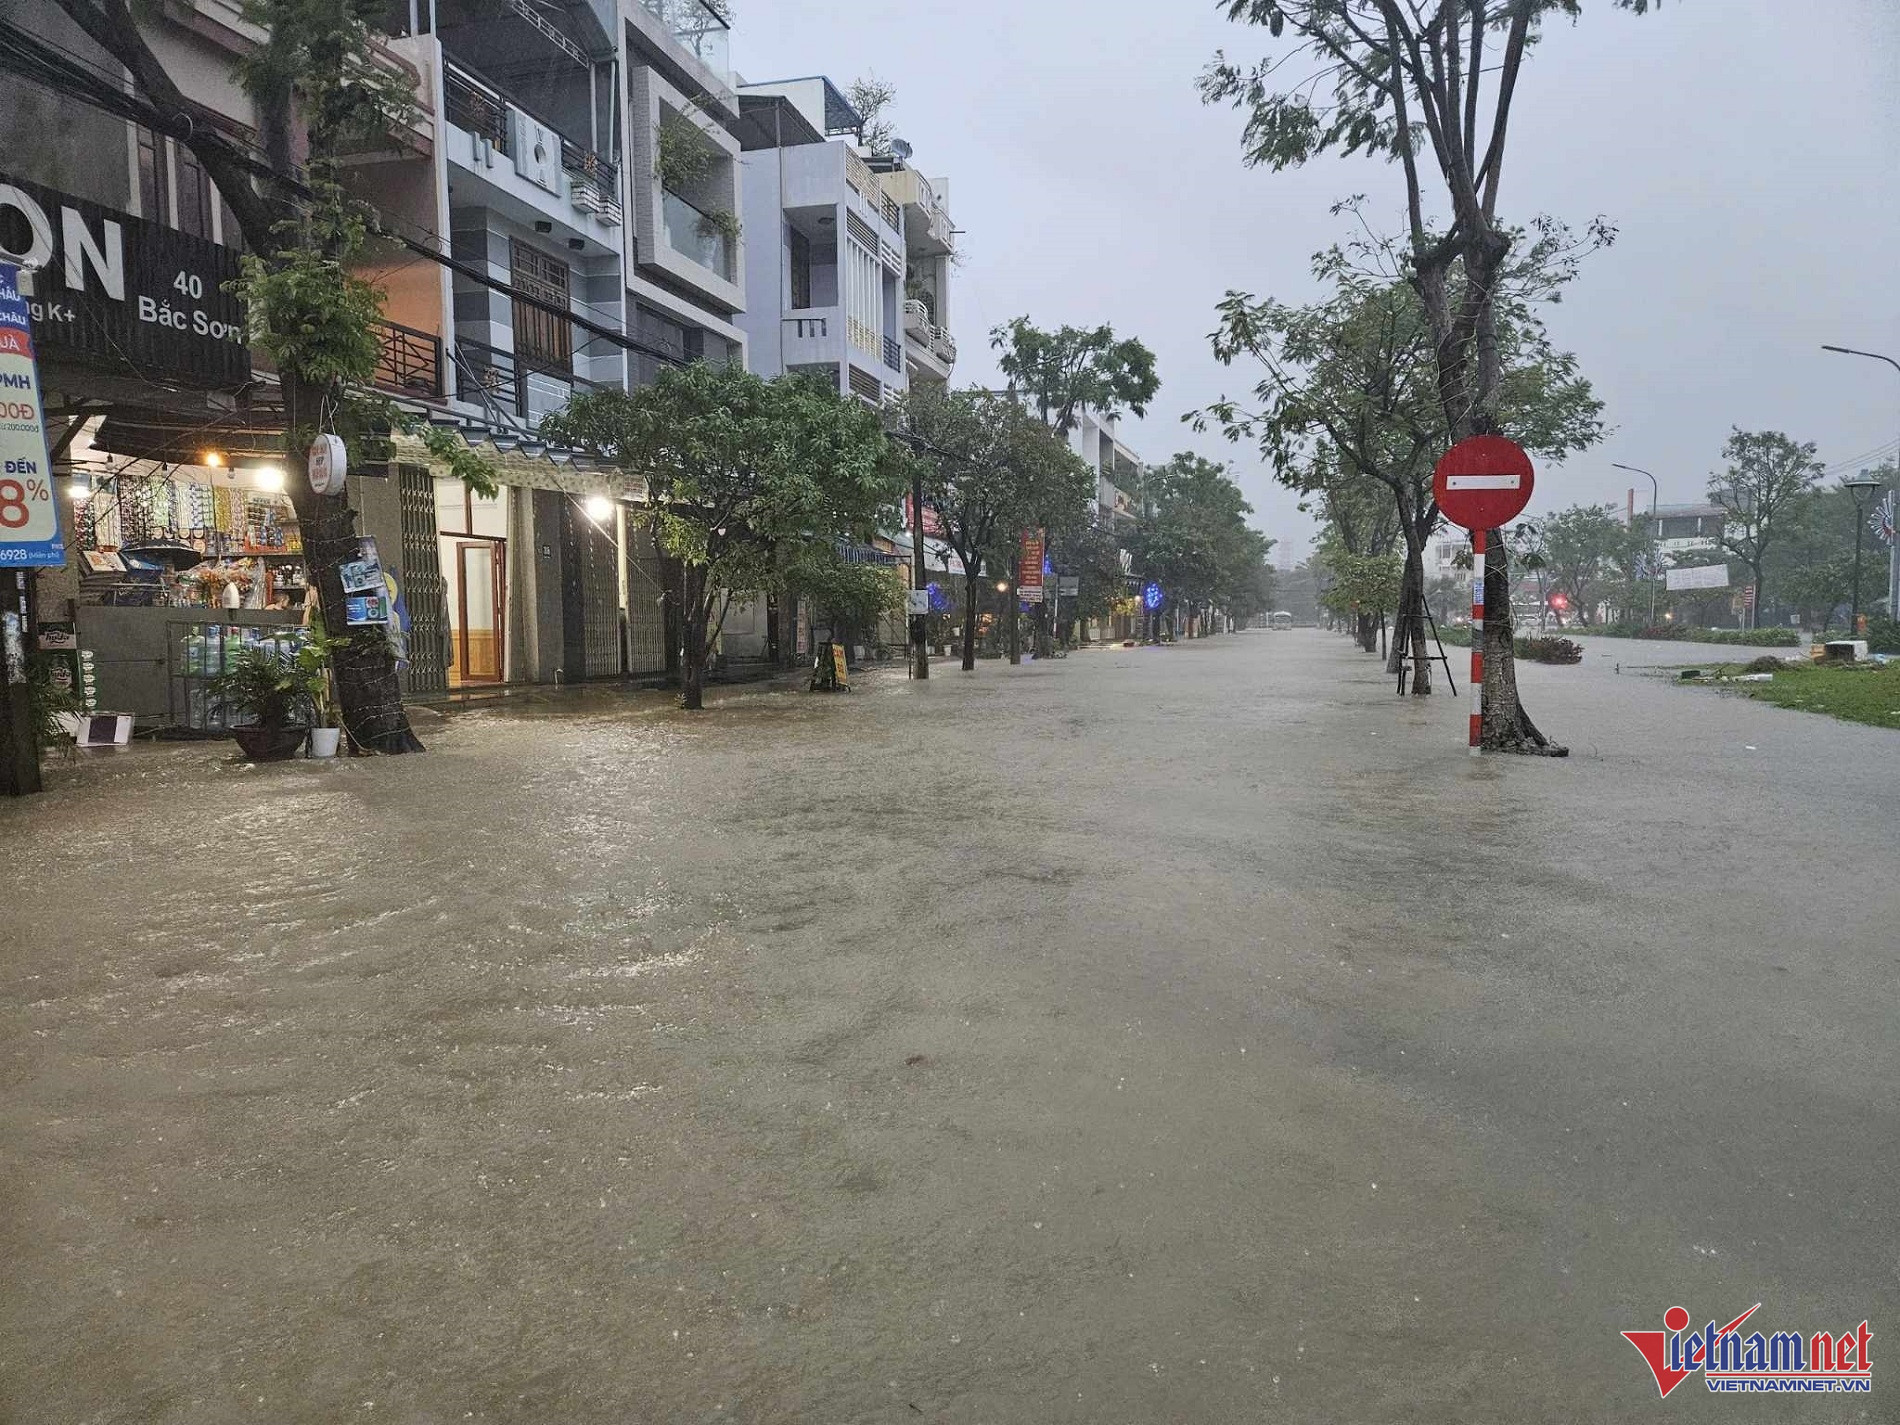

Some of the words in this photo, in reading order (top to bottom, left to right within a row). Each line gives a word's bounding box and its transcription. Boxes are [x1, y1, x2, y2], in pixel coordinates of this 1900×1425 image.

[173, 271, 202, 299] 40
[49, 302, 76, 322] K+
[139, 295, 187, 330] Bắc
[193, 310, 241, 344] Sơn
[5, 457, 37, 475] ĐẾN
